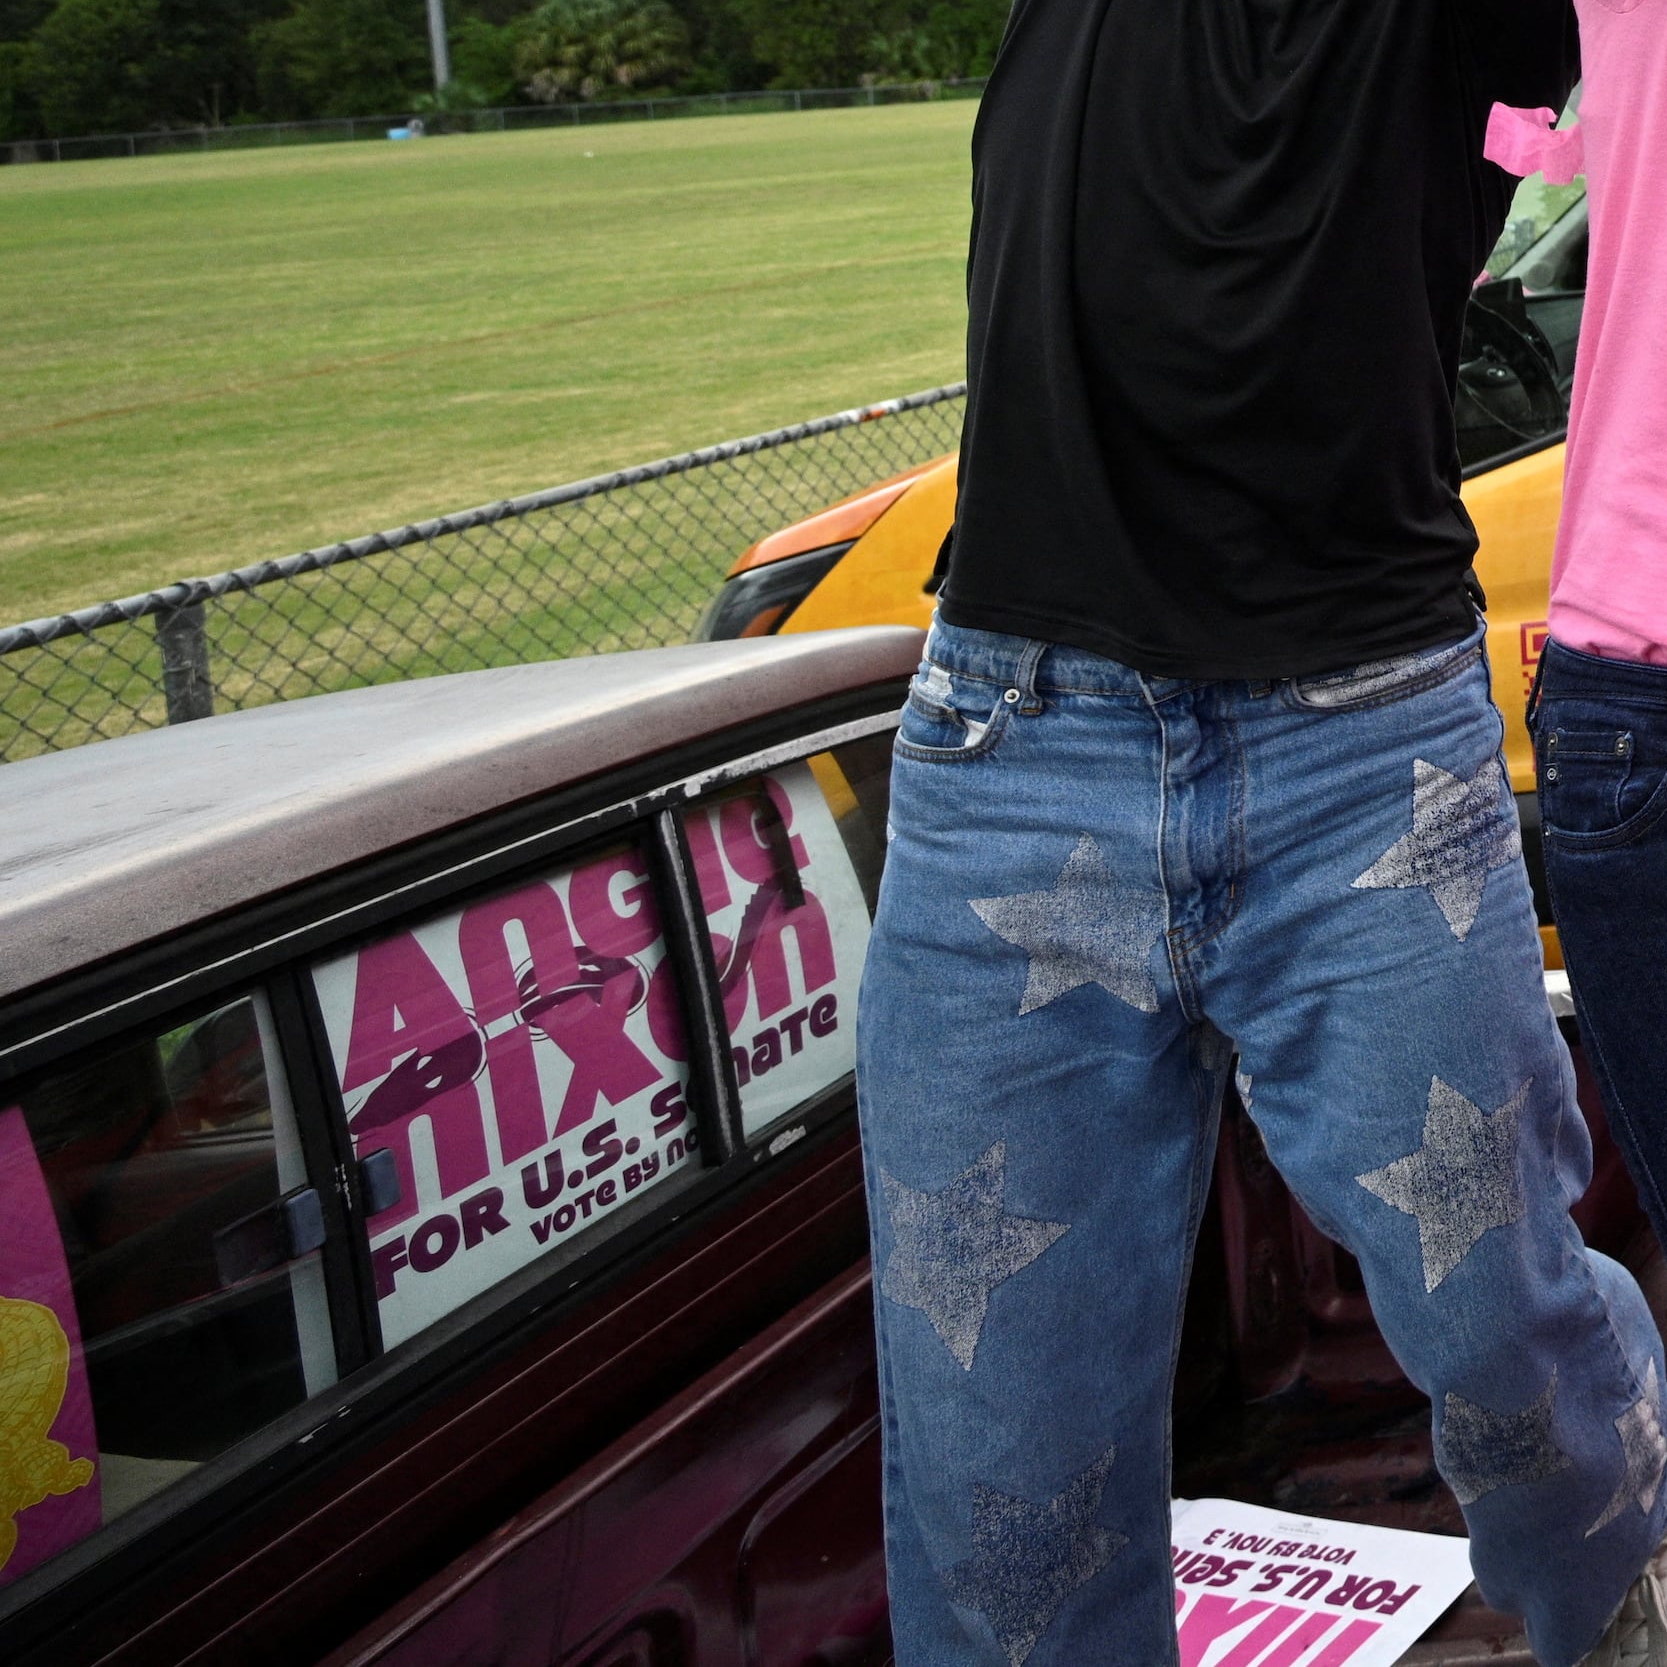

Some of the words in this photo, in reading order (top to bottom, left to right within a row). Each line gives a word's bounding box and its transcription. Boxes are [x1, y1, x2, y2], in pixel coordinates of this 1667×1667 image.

[372, 1187, 511, 1303] FOR
[520, 1119, 642, 1210] U.S.
[1250, 1564, 1334, 1601] U.S.
[1325, 1575, 1422, 1615] FOR
